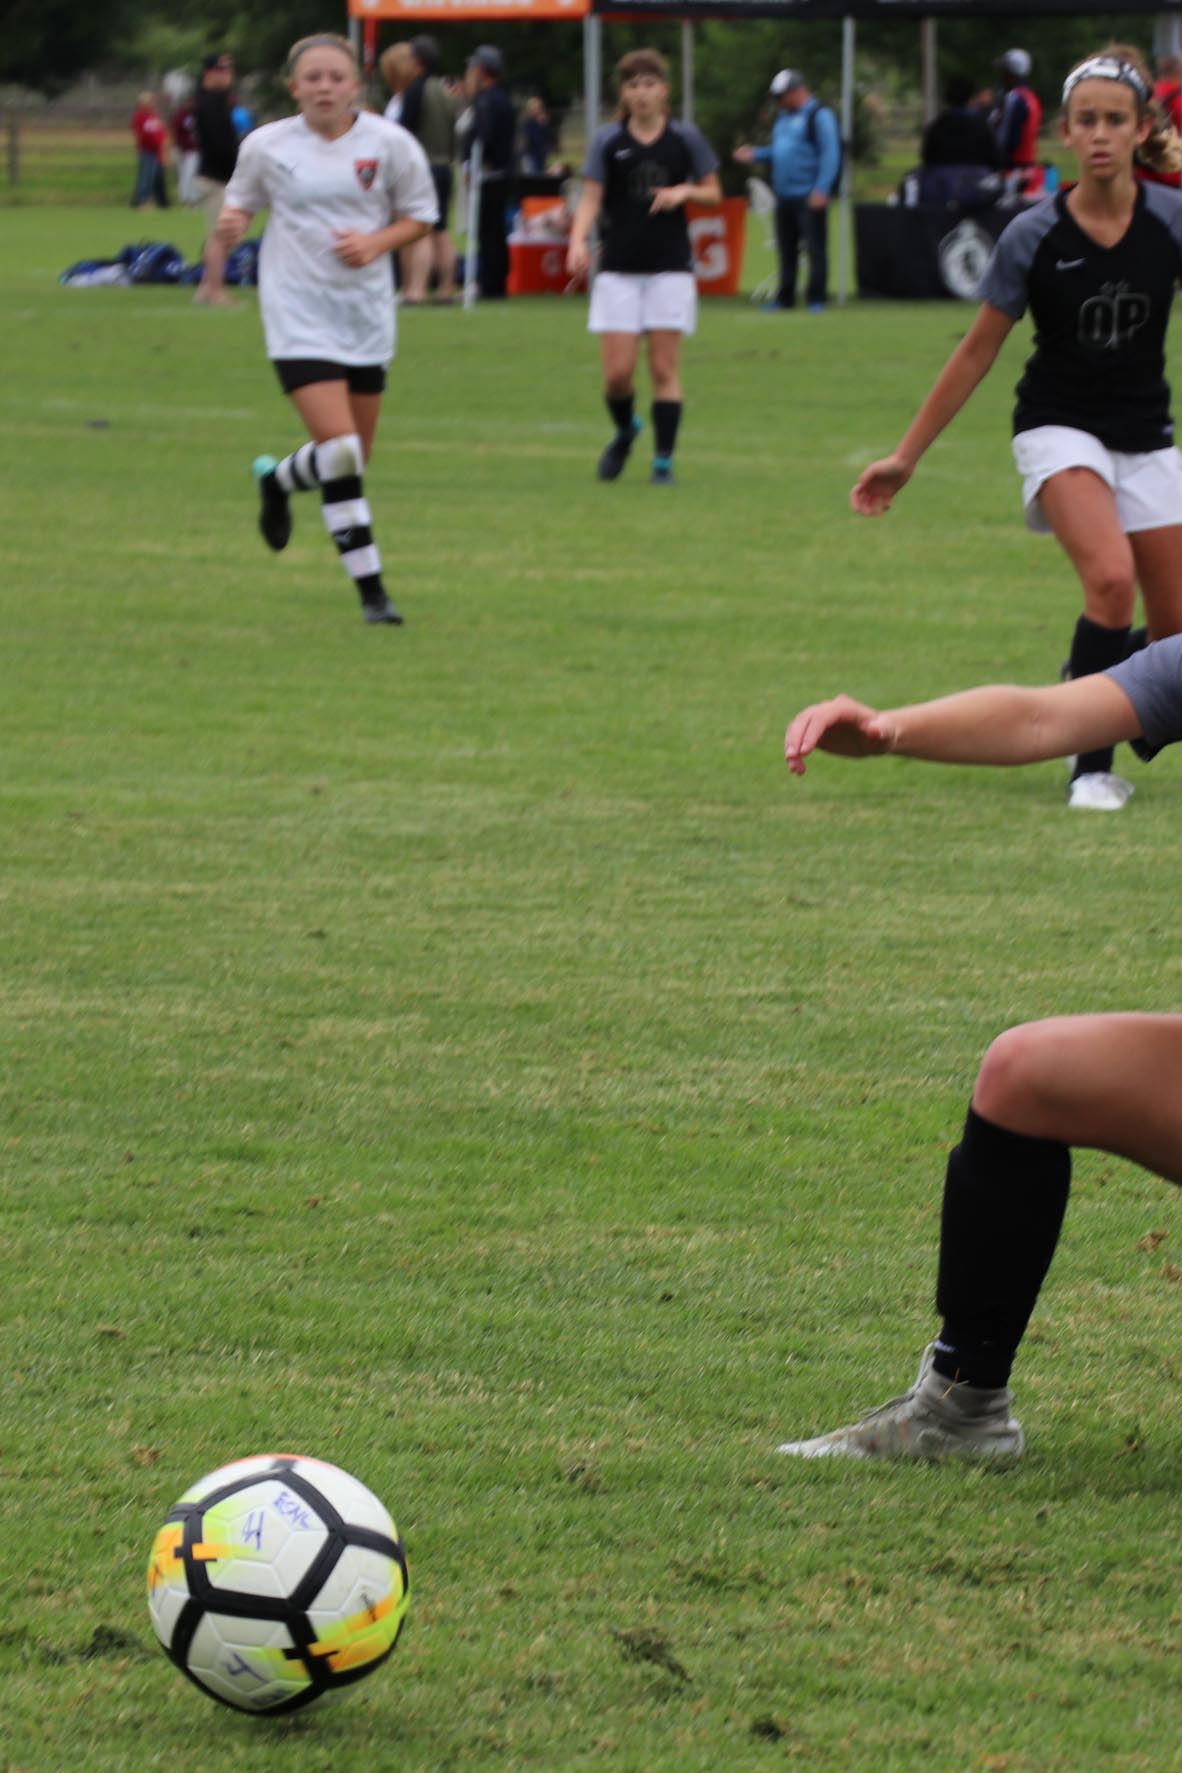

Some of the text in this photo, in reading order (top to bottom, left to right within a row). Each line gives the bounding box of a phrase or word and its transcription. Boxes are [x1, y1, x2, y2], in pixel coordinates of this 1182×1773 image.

[688, 216, 728, 280] G
[1077, 292, 1151, 351] OP
[242, 1510, 265, 1552] 4
